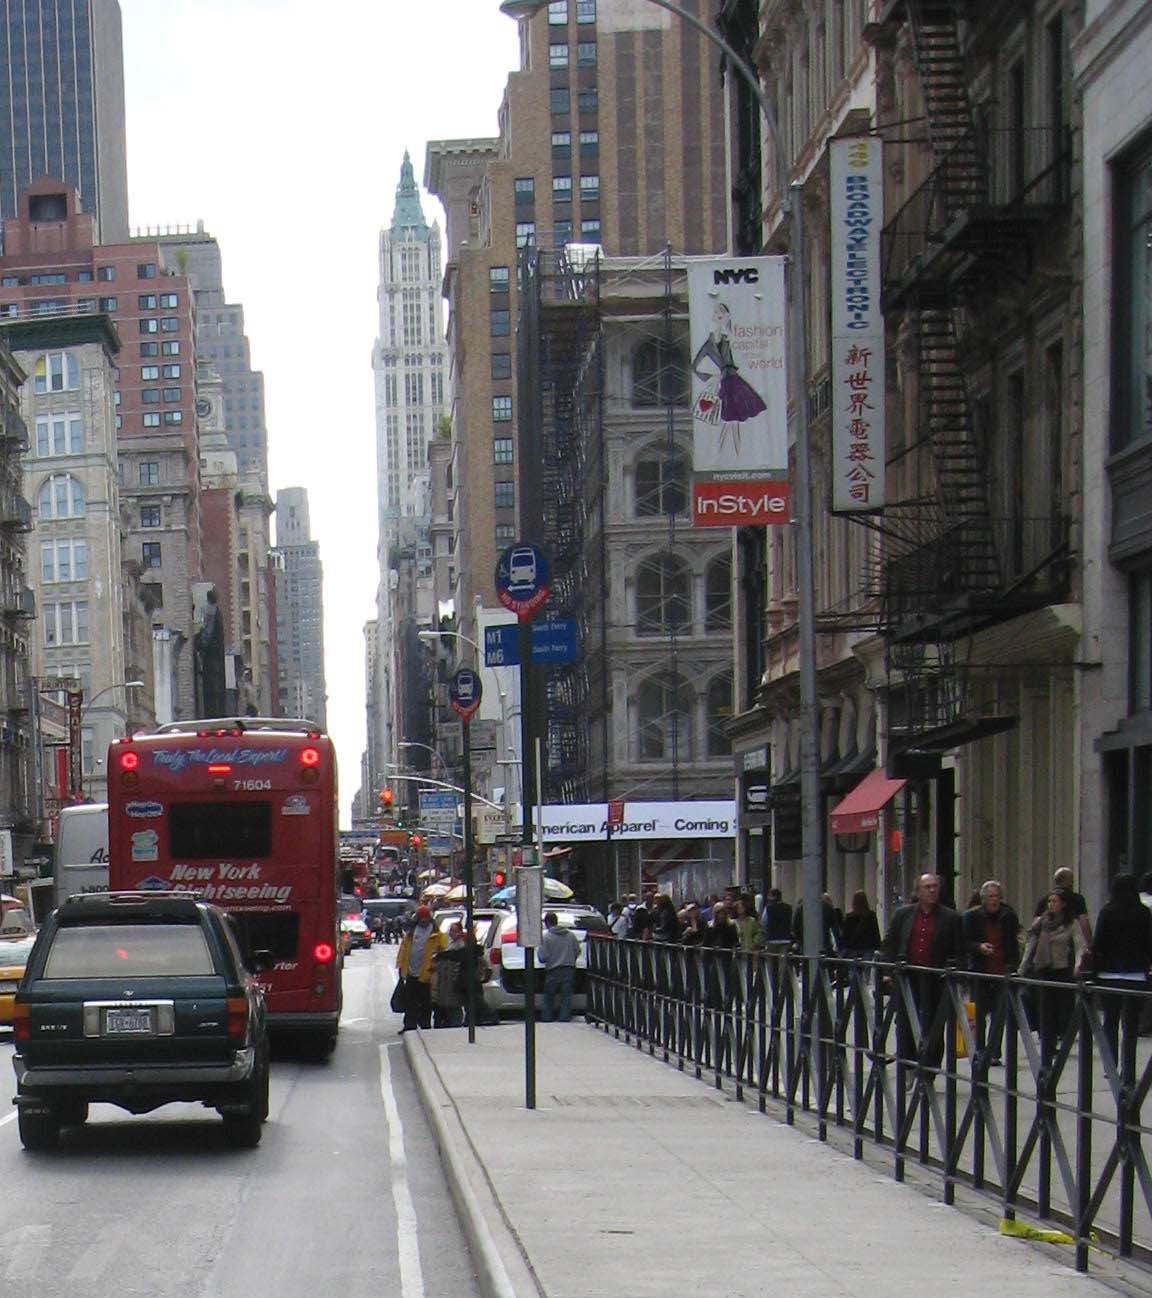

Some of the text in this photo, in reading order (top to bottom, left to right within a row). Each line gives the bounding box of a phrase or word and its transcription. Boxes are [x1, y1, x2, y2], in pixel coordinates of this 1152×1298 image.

[844, 176, 872, 329] BROADWAY ELECTRONIC
[714, 269, 759, 285] NYC
[734, 324, 783, 337] fashion
[749, 358, 783, 369] world
[844, 344, 875, 503] 新世界電器公司
[698, 496, 785, 516] InStyle
[486, 631, 502, 645] M1
[486, 650, 504, 665] M6
[152, 749, 186, 772] Truly
[234, 780, 272, 790] 71604
[534, 824, 596, 835] merican
[600, 819, 656, 836] Apparel
[674, 818, 729, 834] Coming
[170, 863, 262, 880] New York
